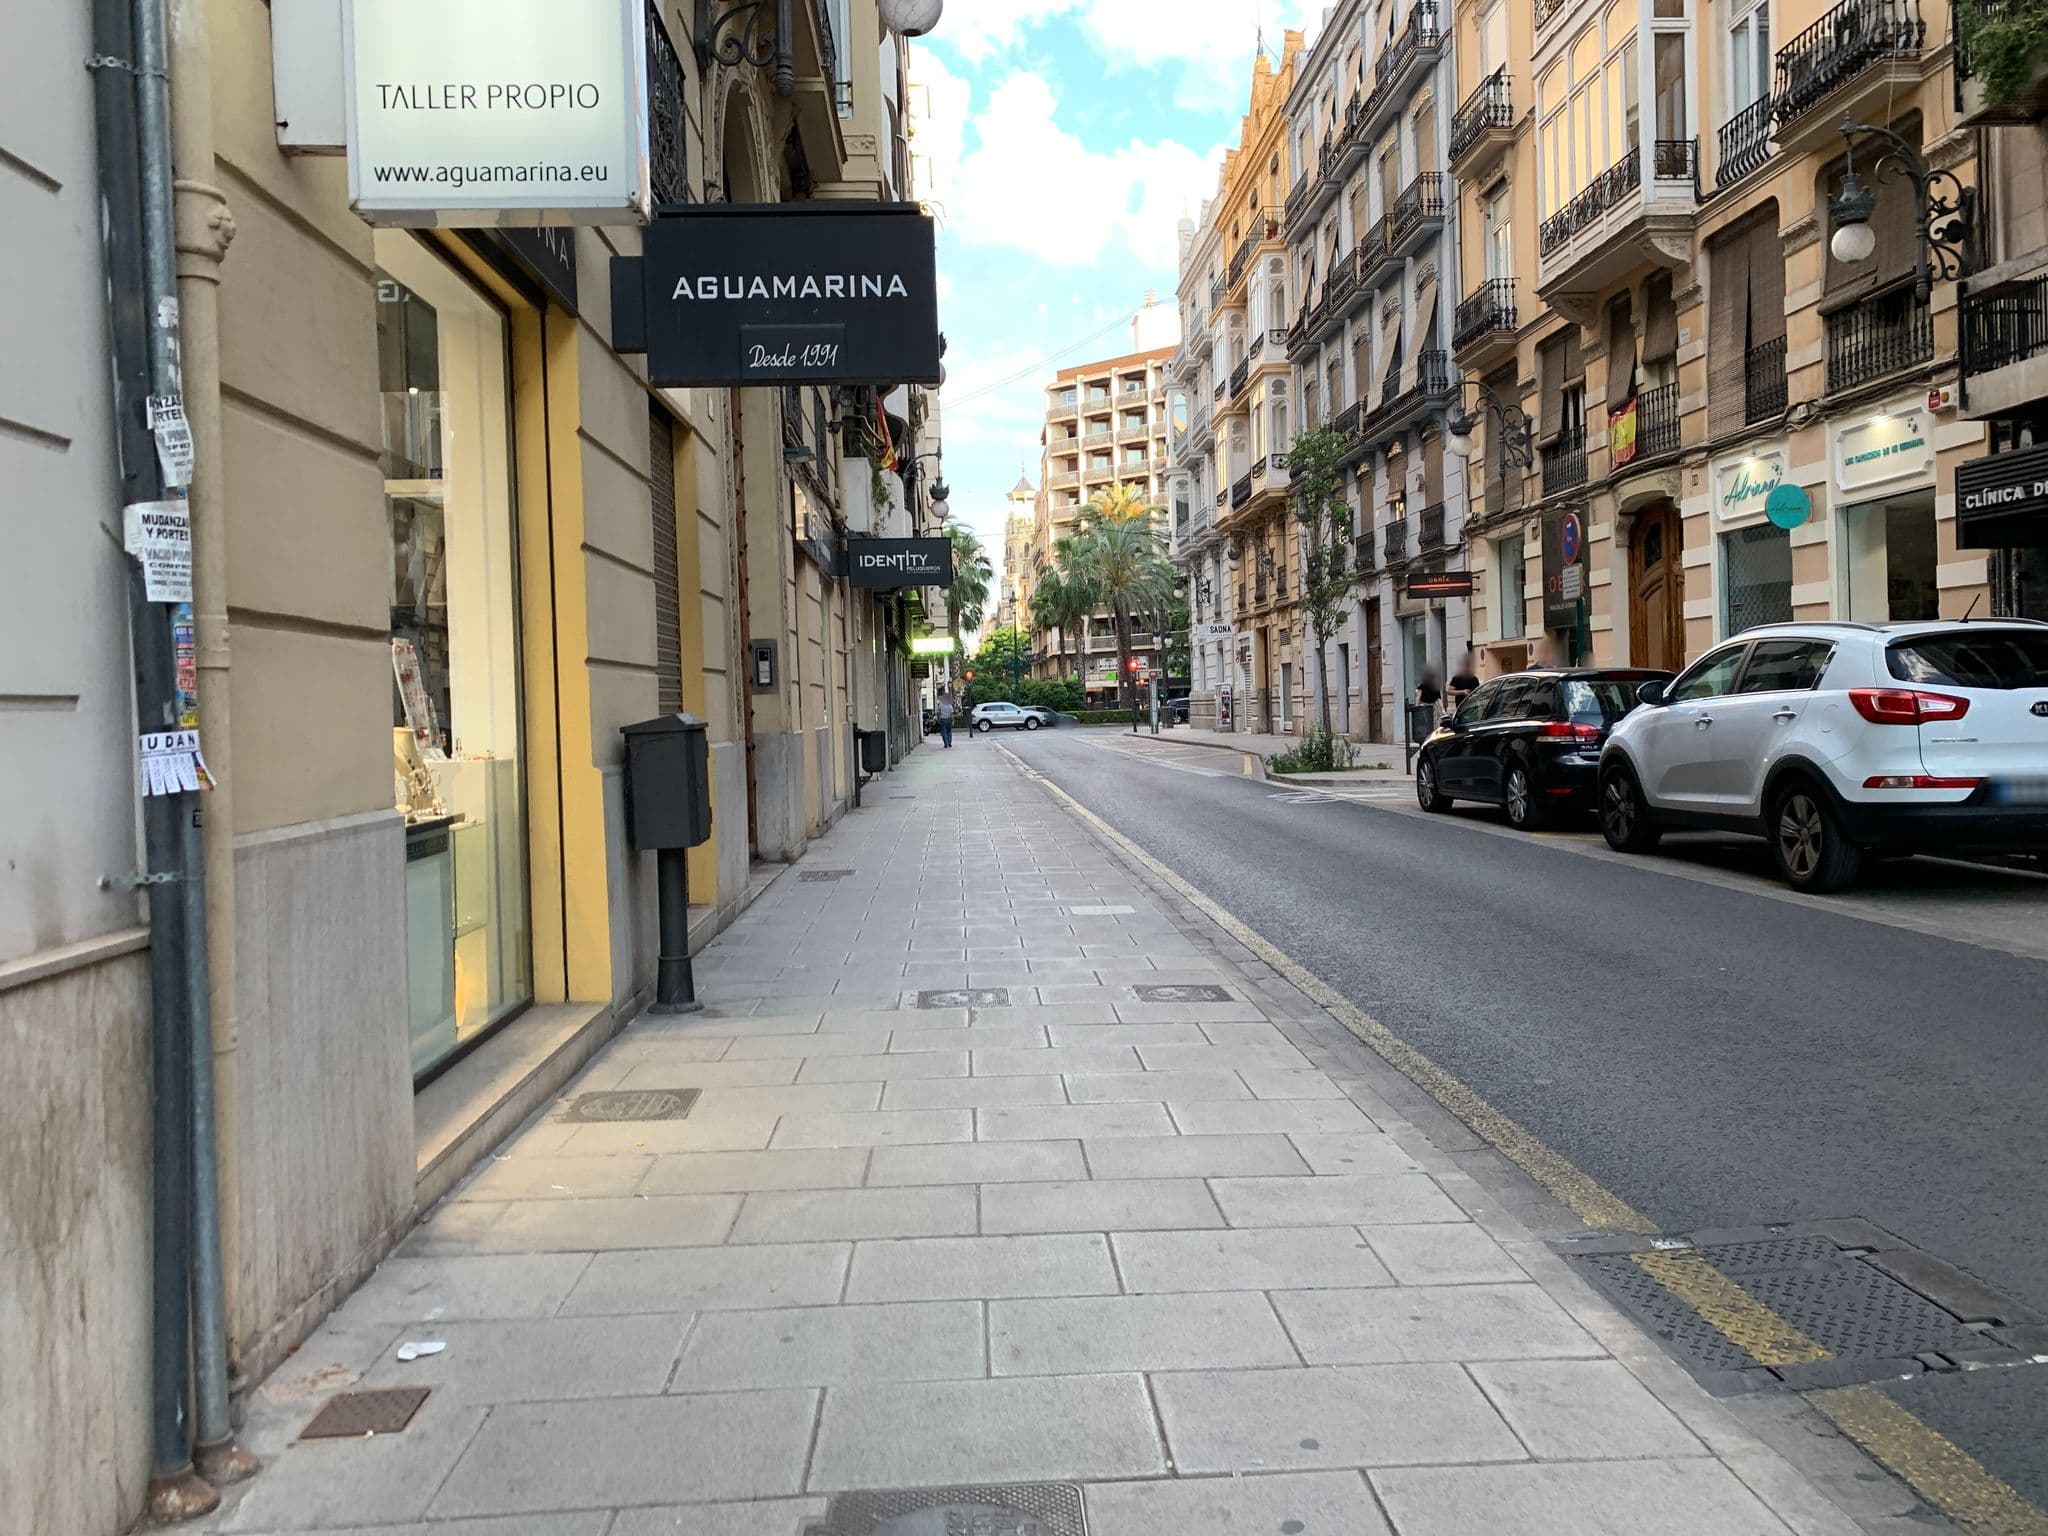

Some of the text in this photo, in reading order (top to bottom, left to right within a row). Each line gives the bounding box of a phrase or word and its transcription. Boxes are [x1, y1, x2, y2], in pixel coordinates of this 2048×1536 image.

[376, 83, 600, 109] TALLER PROPIO
[373, 161, 608, 188] www.aguamarina.eu
[671, 273, 909, 300] AGUAMARINA
[749, 342, 839, 368] Desde 1991
[1965, 486, 2027, 509] CLÍNICA
[146, 527, 153, 539] Y
[859, 550, 928, 571] IDENTITY
[140, 733, 196, 750] UDAN
